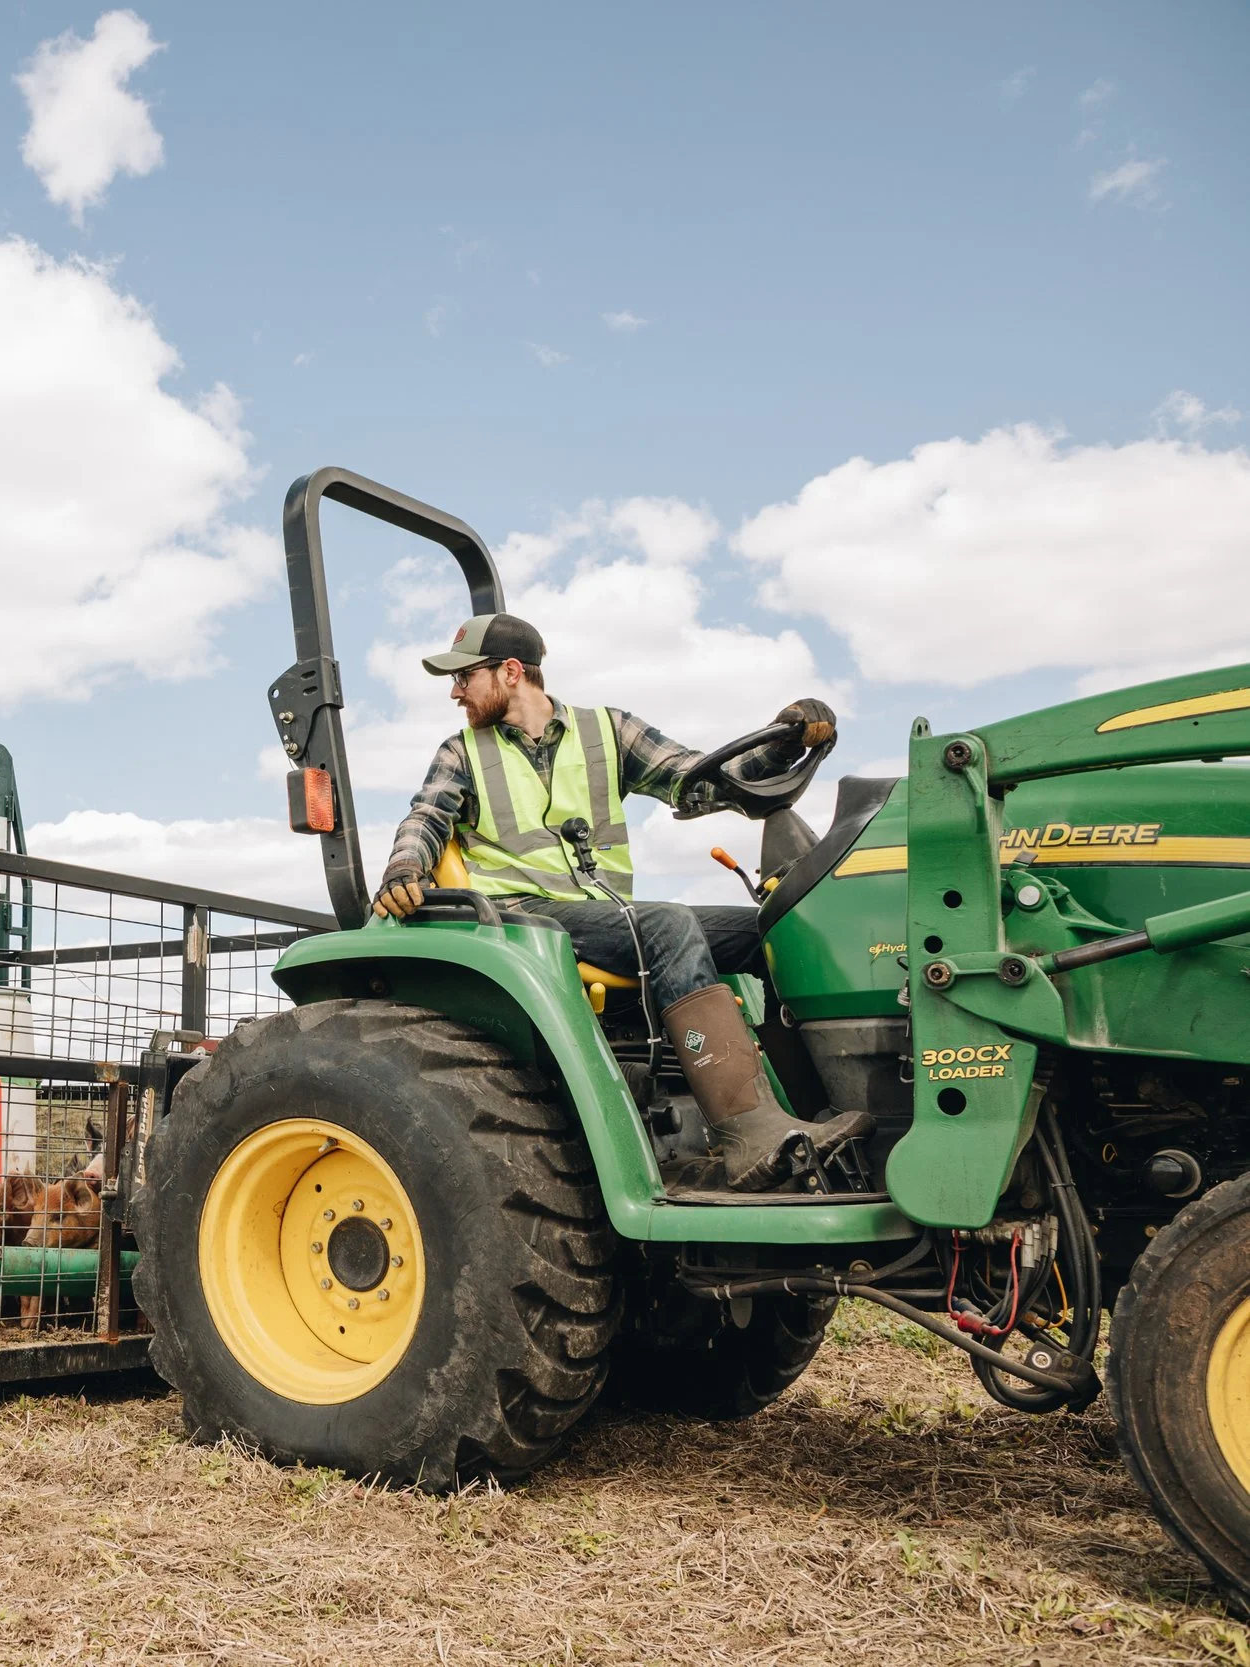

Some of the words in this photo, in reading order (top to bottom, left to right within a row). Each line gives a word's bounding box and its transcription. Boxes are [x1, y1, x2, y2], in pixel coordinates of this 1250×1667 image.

[1000, 828, 1040, 848] HN
[1040, 823, 1163, 847] DEERE
[868, 943, 908, 955] eHydr
[921, 1043, 1013, 1066] 300CX
[928, 1064, 1005, 1081] LOADER
[139, 1088, 149, 1135] Pride
